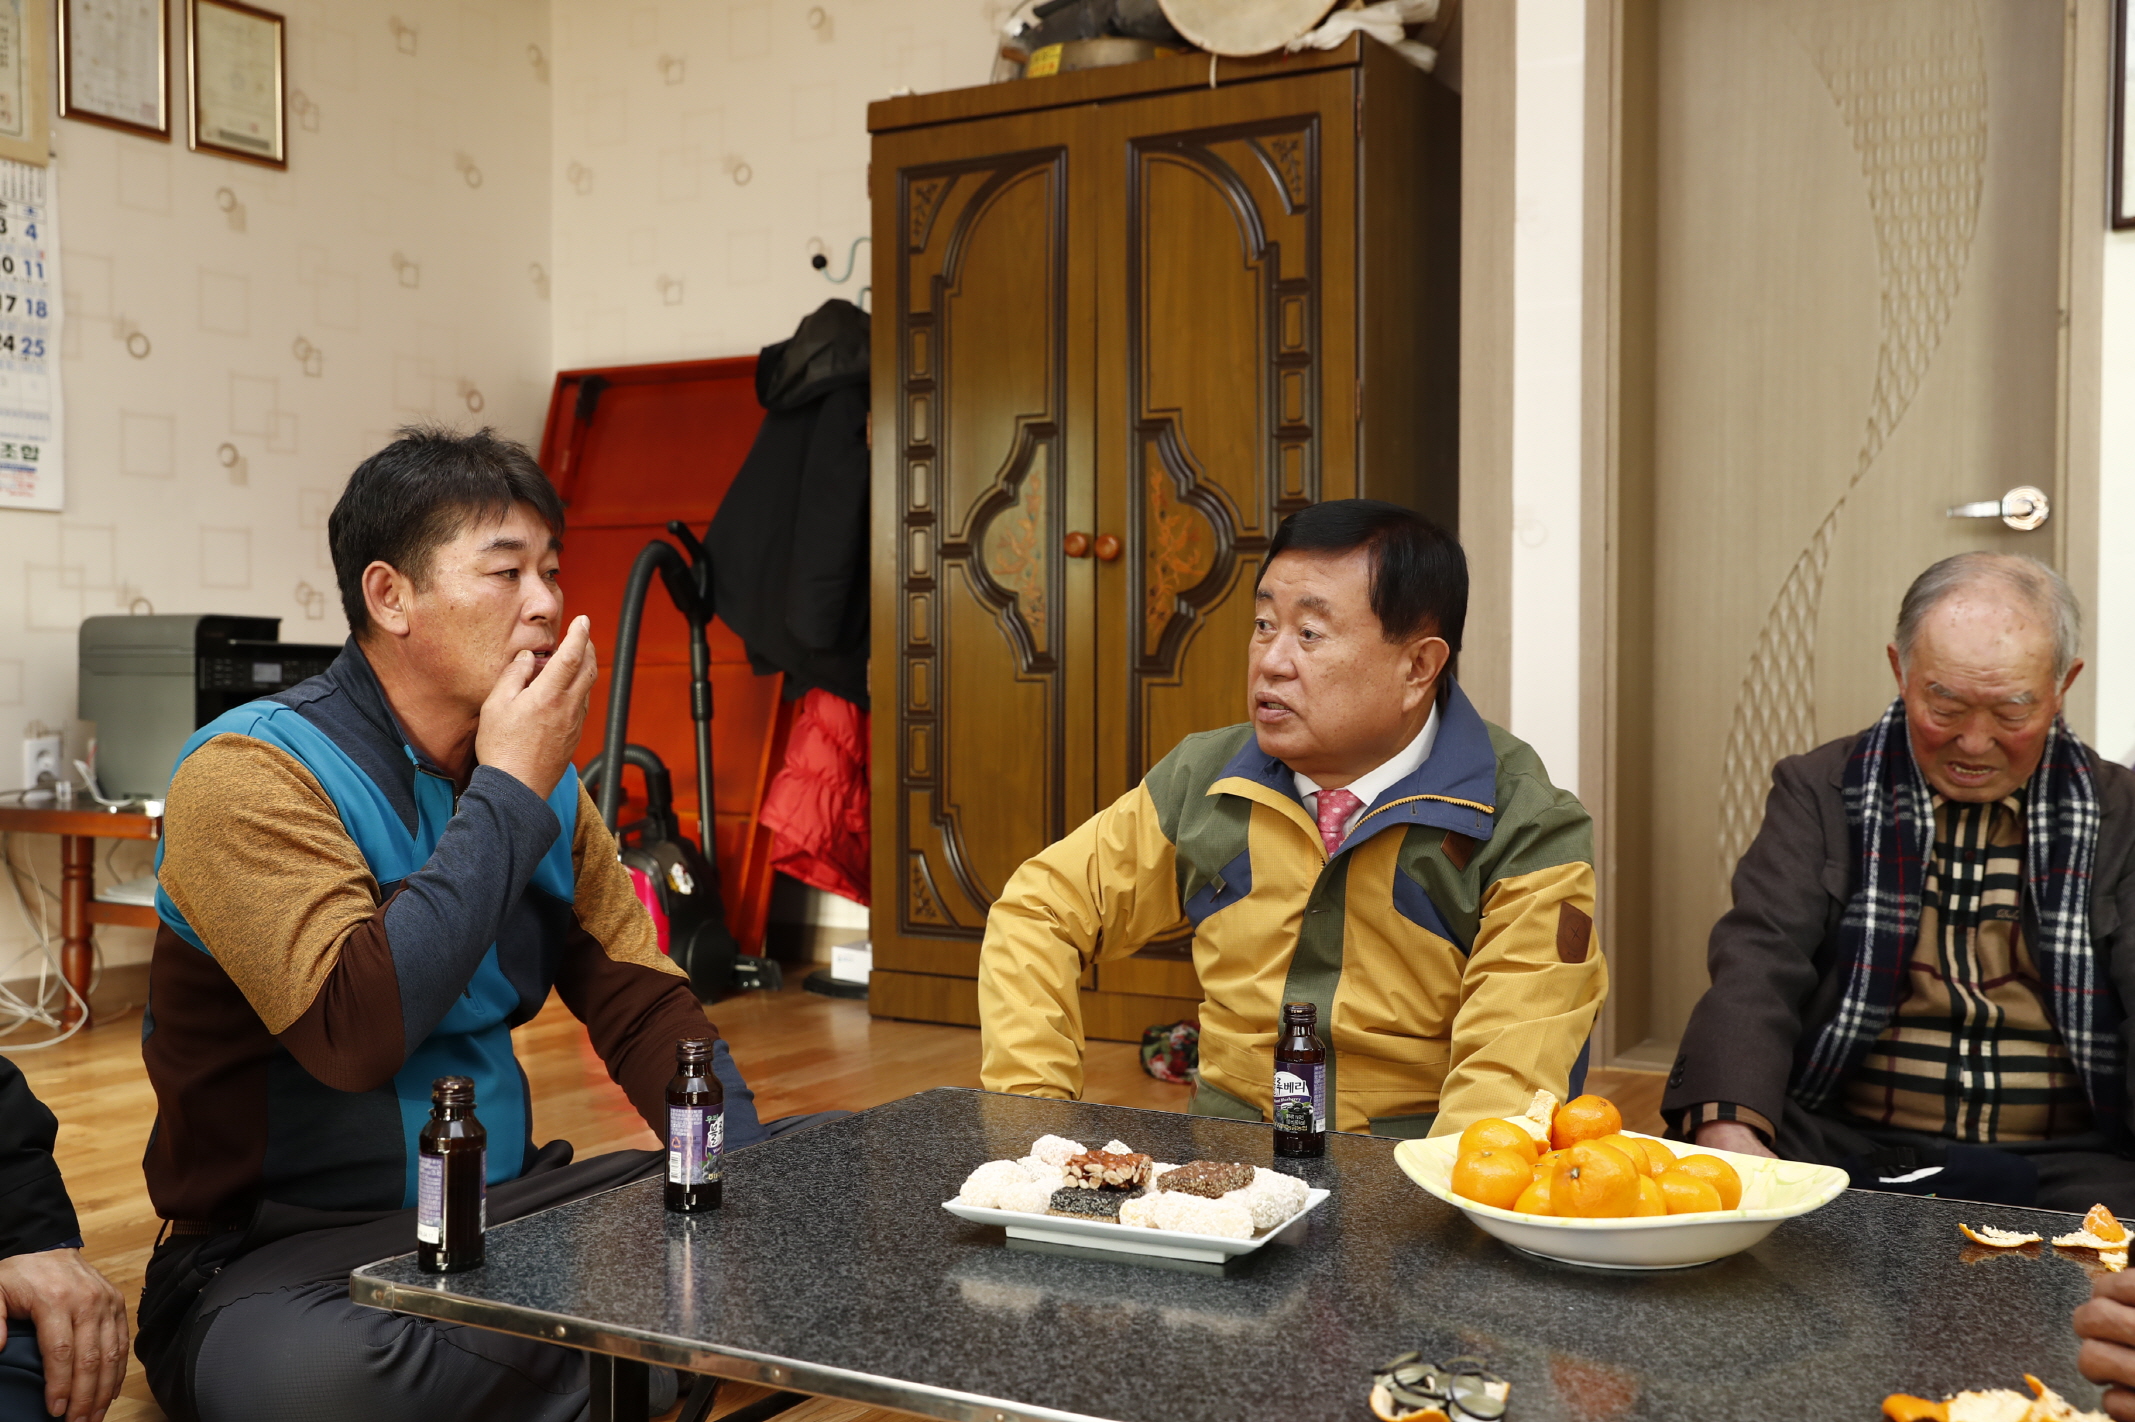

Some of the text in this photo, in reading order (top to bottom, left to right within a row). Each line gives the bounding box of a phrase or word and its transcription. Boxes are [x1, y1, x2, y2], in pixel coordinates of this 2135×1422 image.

[25, 223, 38, 240] 4
[24, 260, 44, 279] 11
[25, 298, 47, 319] 18
[0, 334, 45, 357] 4 25
